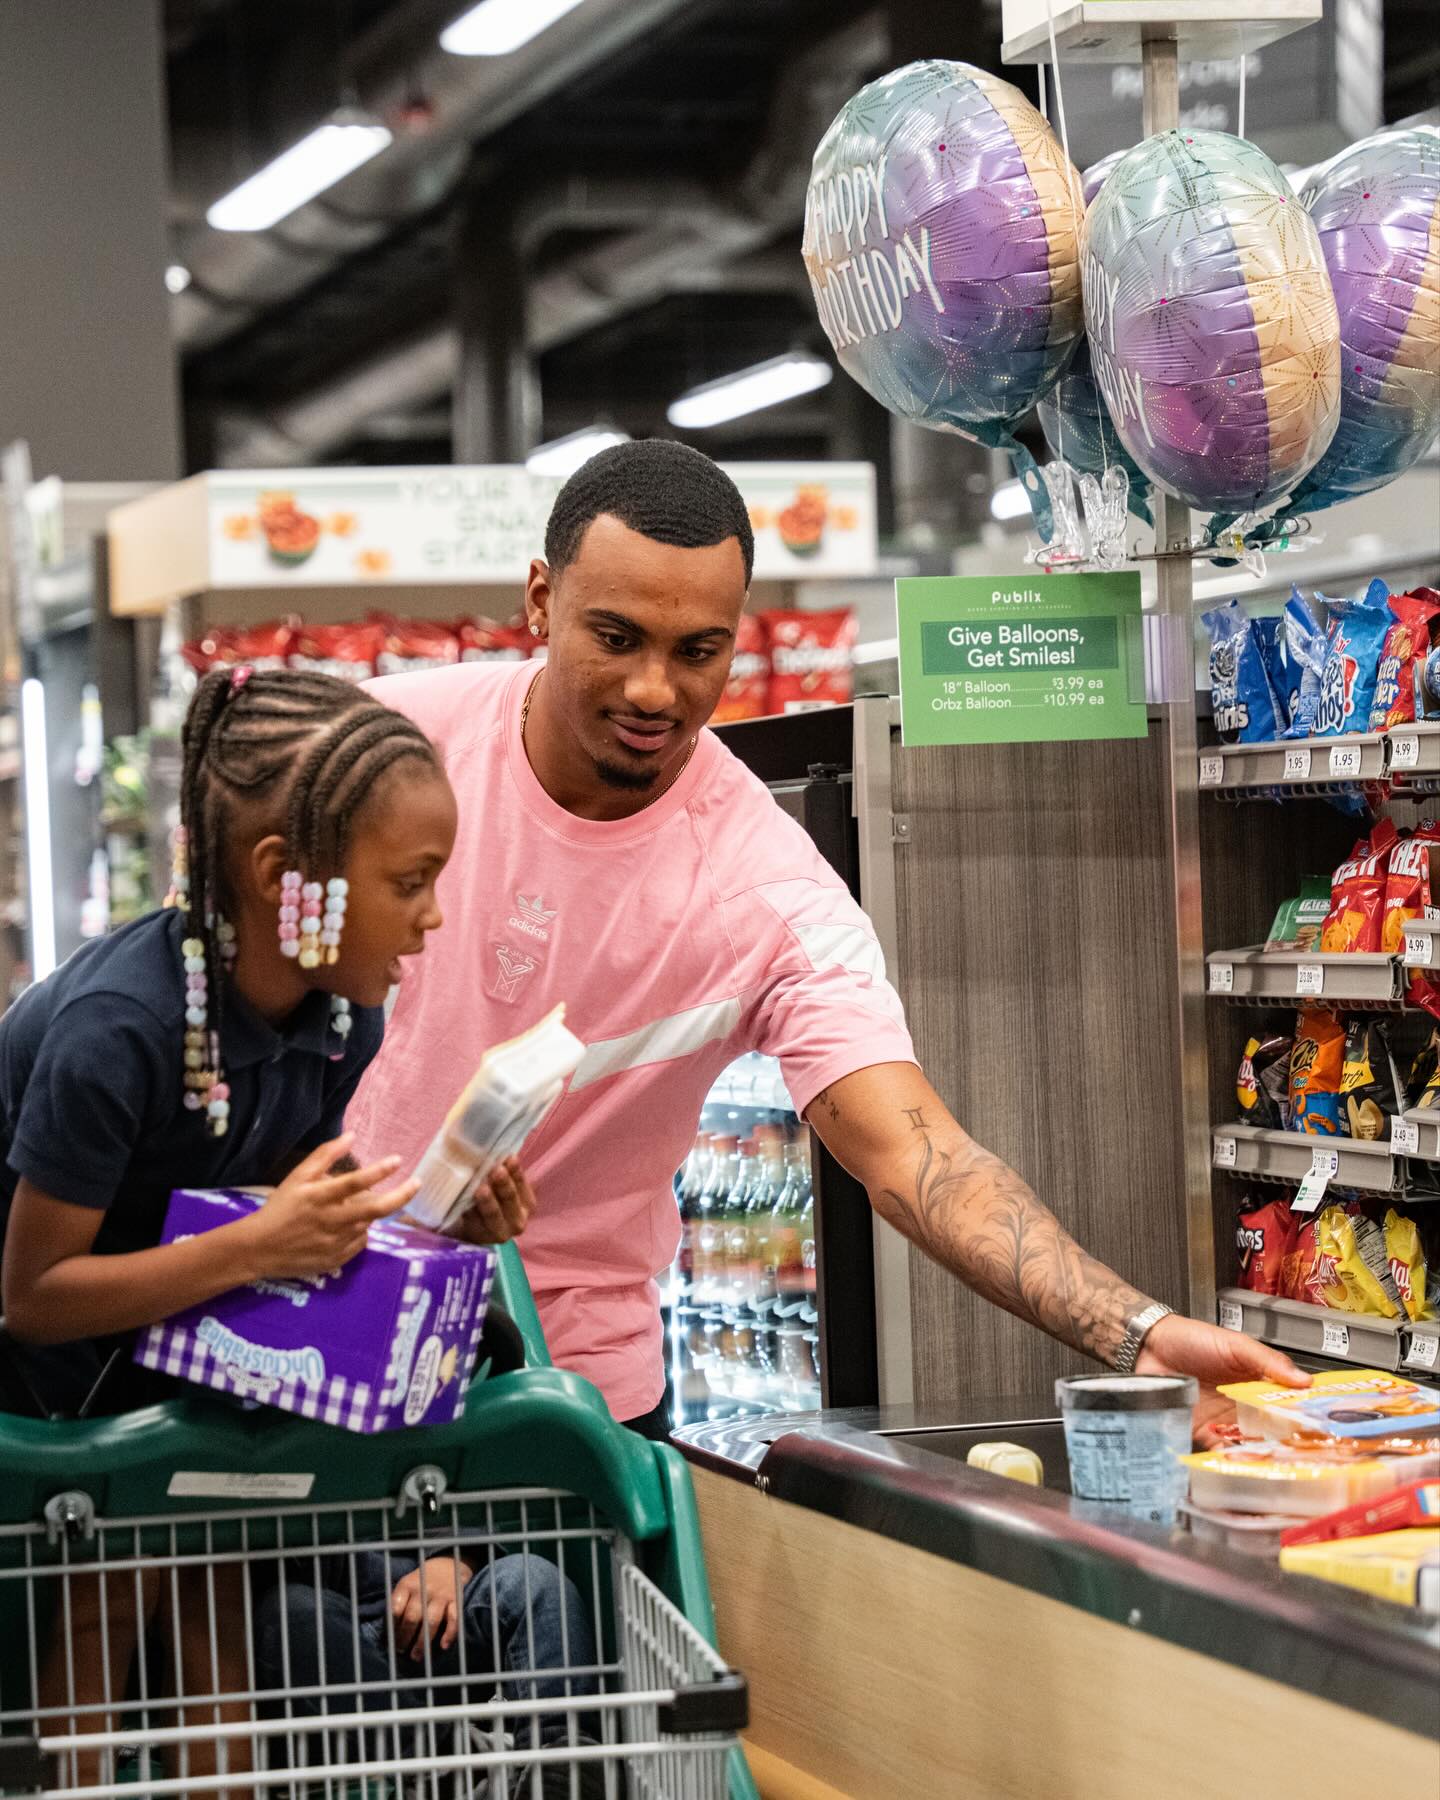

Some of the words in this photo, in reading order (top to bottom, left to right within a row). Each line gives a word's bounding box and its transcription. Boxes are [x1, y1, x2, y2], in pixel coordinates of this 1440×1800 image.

[992, 590, 1041, 604] Publix
[949, 626, 993, 645] Give
[998, 624, 1085, 645] Balloons,
[967, 648, 1004, 667] Get
[1009, 646, 1076, 666] Smiles!
[942, 682, 962, 694] 18"
[965, 681, 1011, 694] Balloon
[1052, 676, 1084, 690] $3.99
[1088, 680, 1104, 689] ea
[931, 698, 962, 711] Orbz
[966, 697, 1012, 710] Balloon
[1044, 693, 1085, 706] $10.99
[1089, 697, 1105, 705] ea
[1395, 743, 1411, 755] 4.99
[1288, 756, 1304, 769] 1.95
[1333, 754, 1353, 766] 1.95
[1202, 763, 1217, 774] 1.95
[509, 917, 549, 941] adidas
[1408, 939, 1424, 952] 4.99
[197, 1317, 325, 1388] Uncrustables
